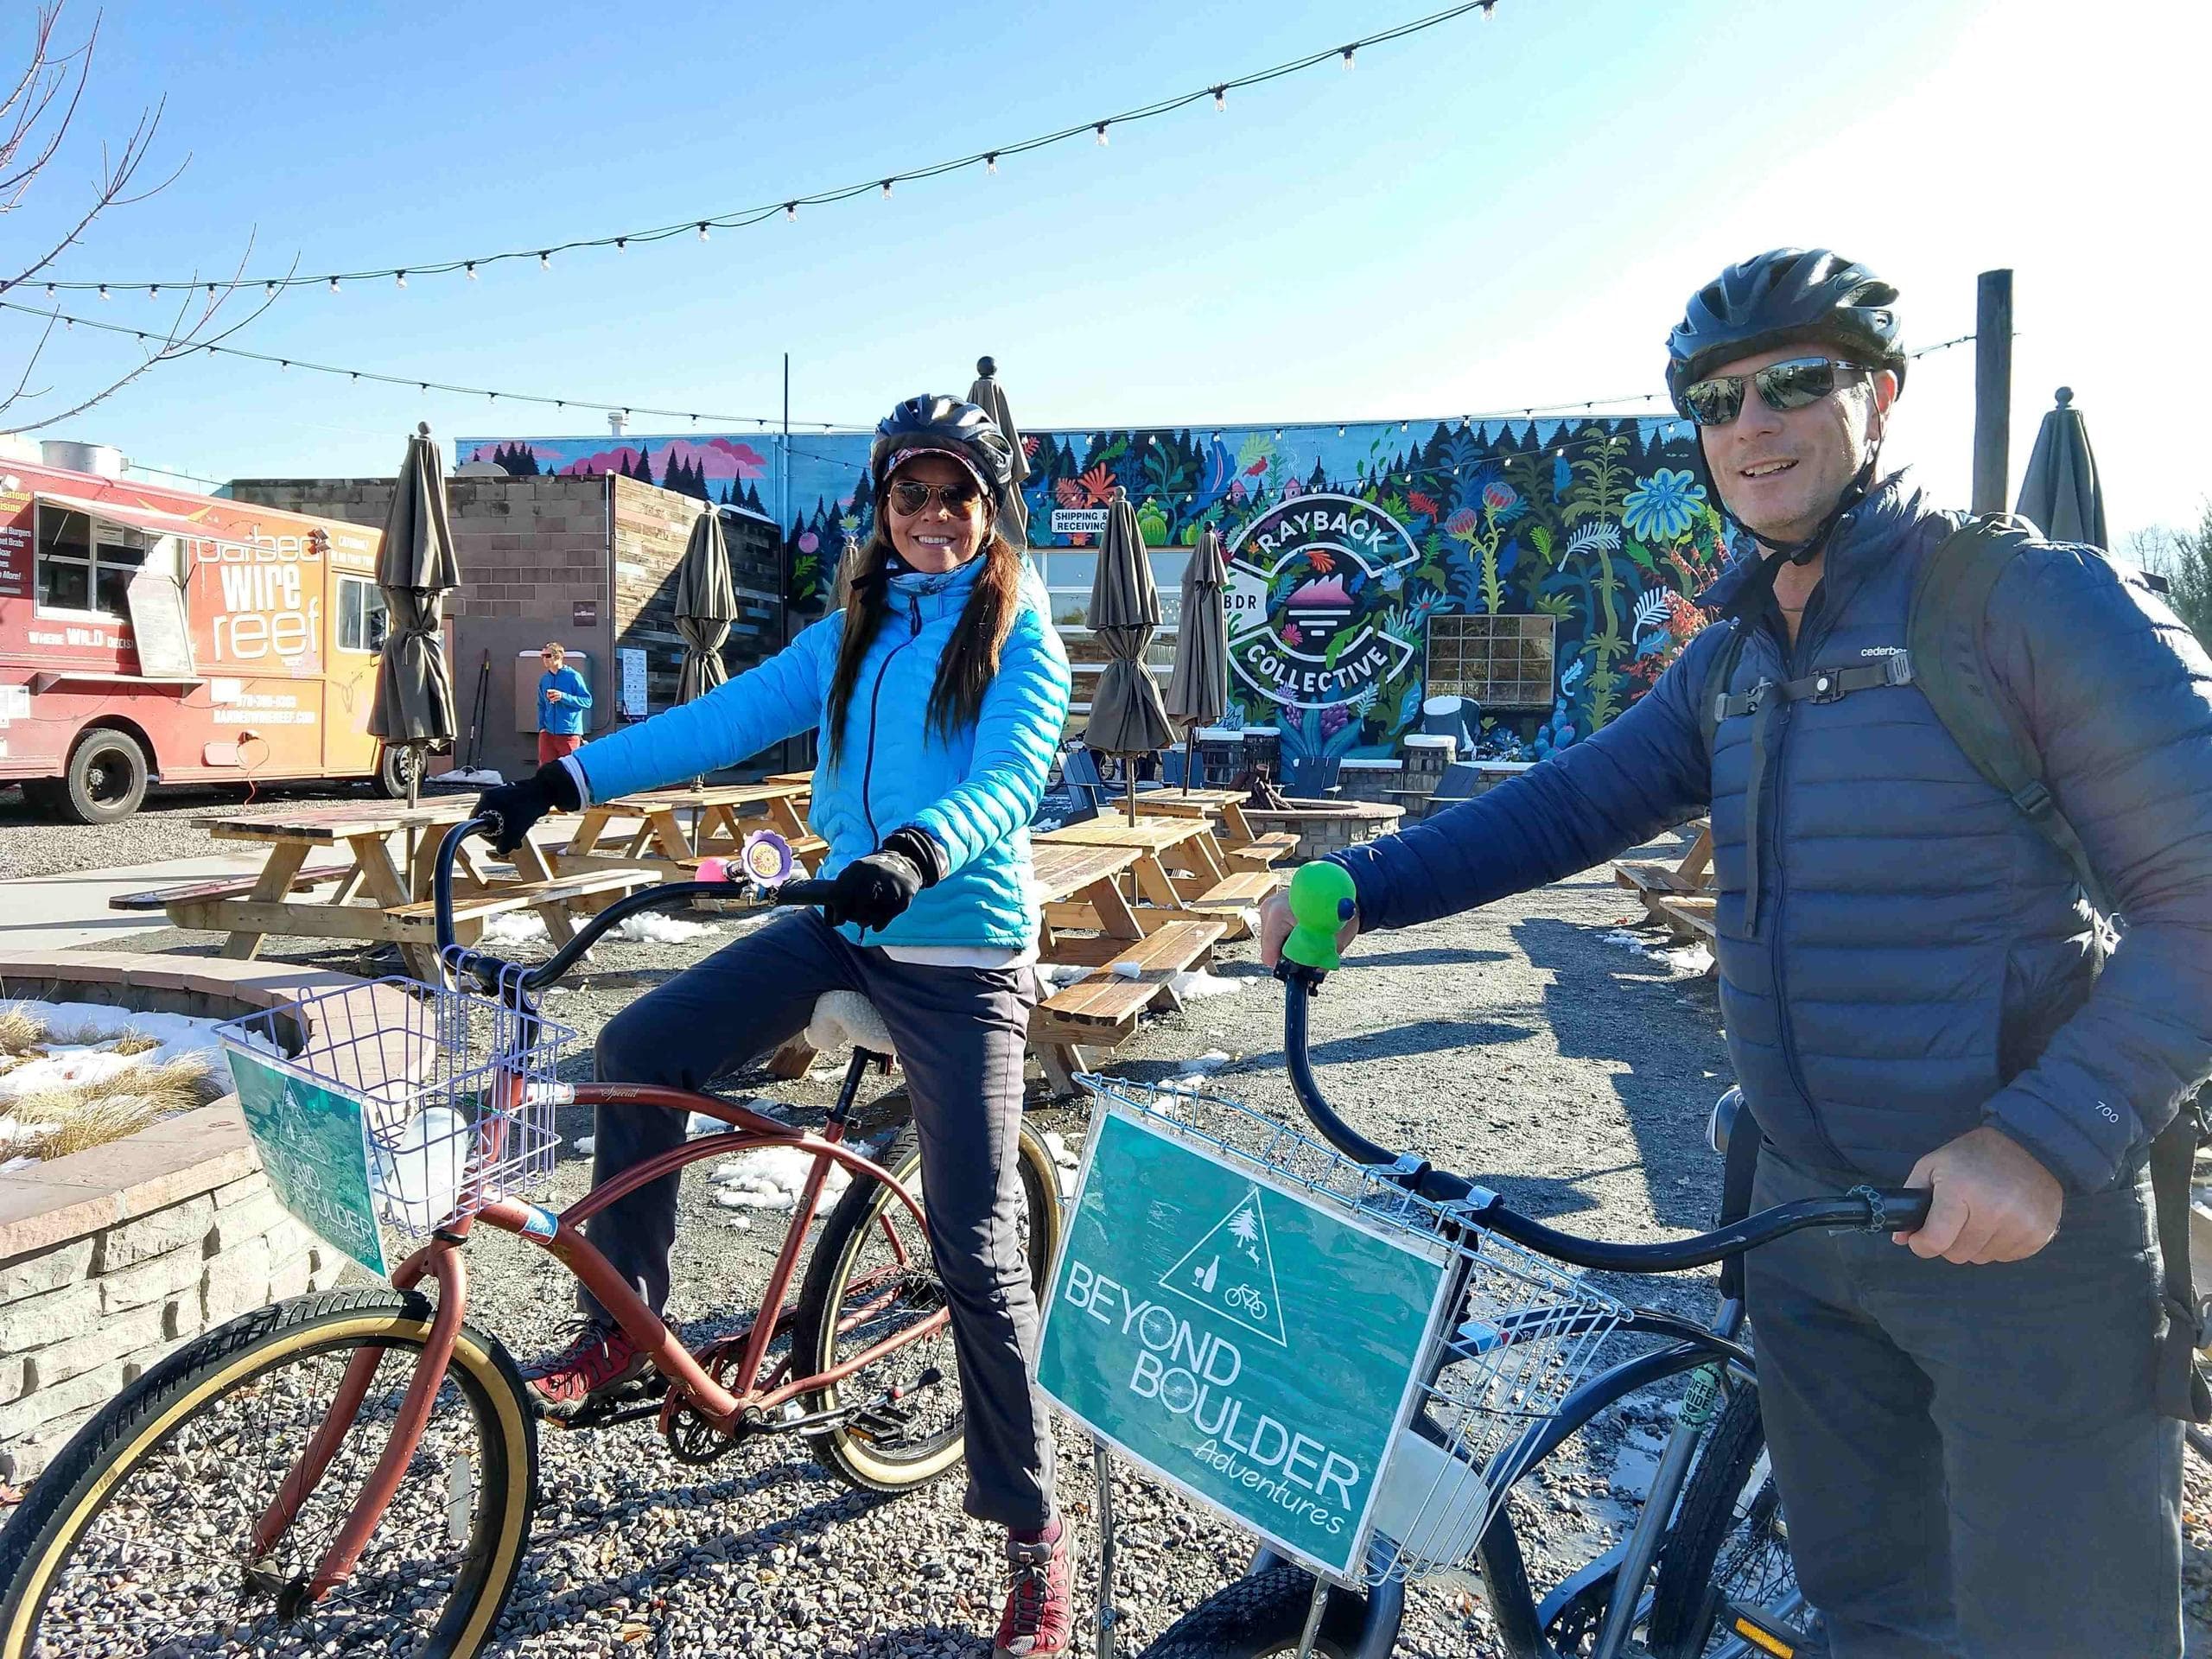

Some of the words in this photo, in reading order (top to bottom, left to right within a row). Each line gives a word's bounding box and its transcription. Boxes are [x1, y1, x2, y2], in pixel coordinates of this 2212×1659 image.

[0, 490, 32, 502] eafood
[1055, 512, 1098, 521] SHIPPING
[1102, 512, 1109, 520] &
[1057, 522, 1106, 531] RECEIVING
[1257, 511, 1389, 555] RAYBACK
[1224, 594, 1256, 609] BDR
[28, 631, 64, 645] WHERE
[67, 627, 104, 646] WILD
[213, 596, 319, 661] reef
[1860, 645, 1908, 657] cederbe
[1247, 644, 1389, 693] COLLECTIVE
[2094, 1100, 2120, 1123] 700
[1063, 1261, 1243, 1387] BEYOND
[1686, 1389, 1711, 1411] RIDE
[1128, 1350, 1361, 1511] BOULDER
[1194, 1440, 1346, 1535] Adventures
